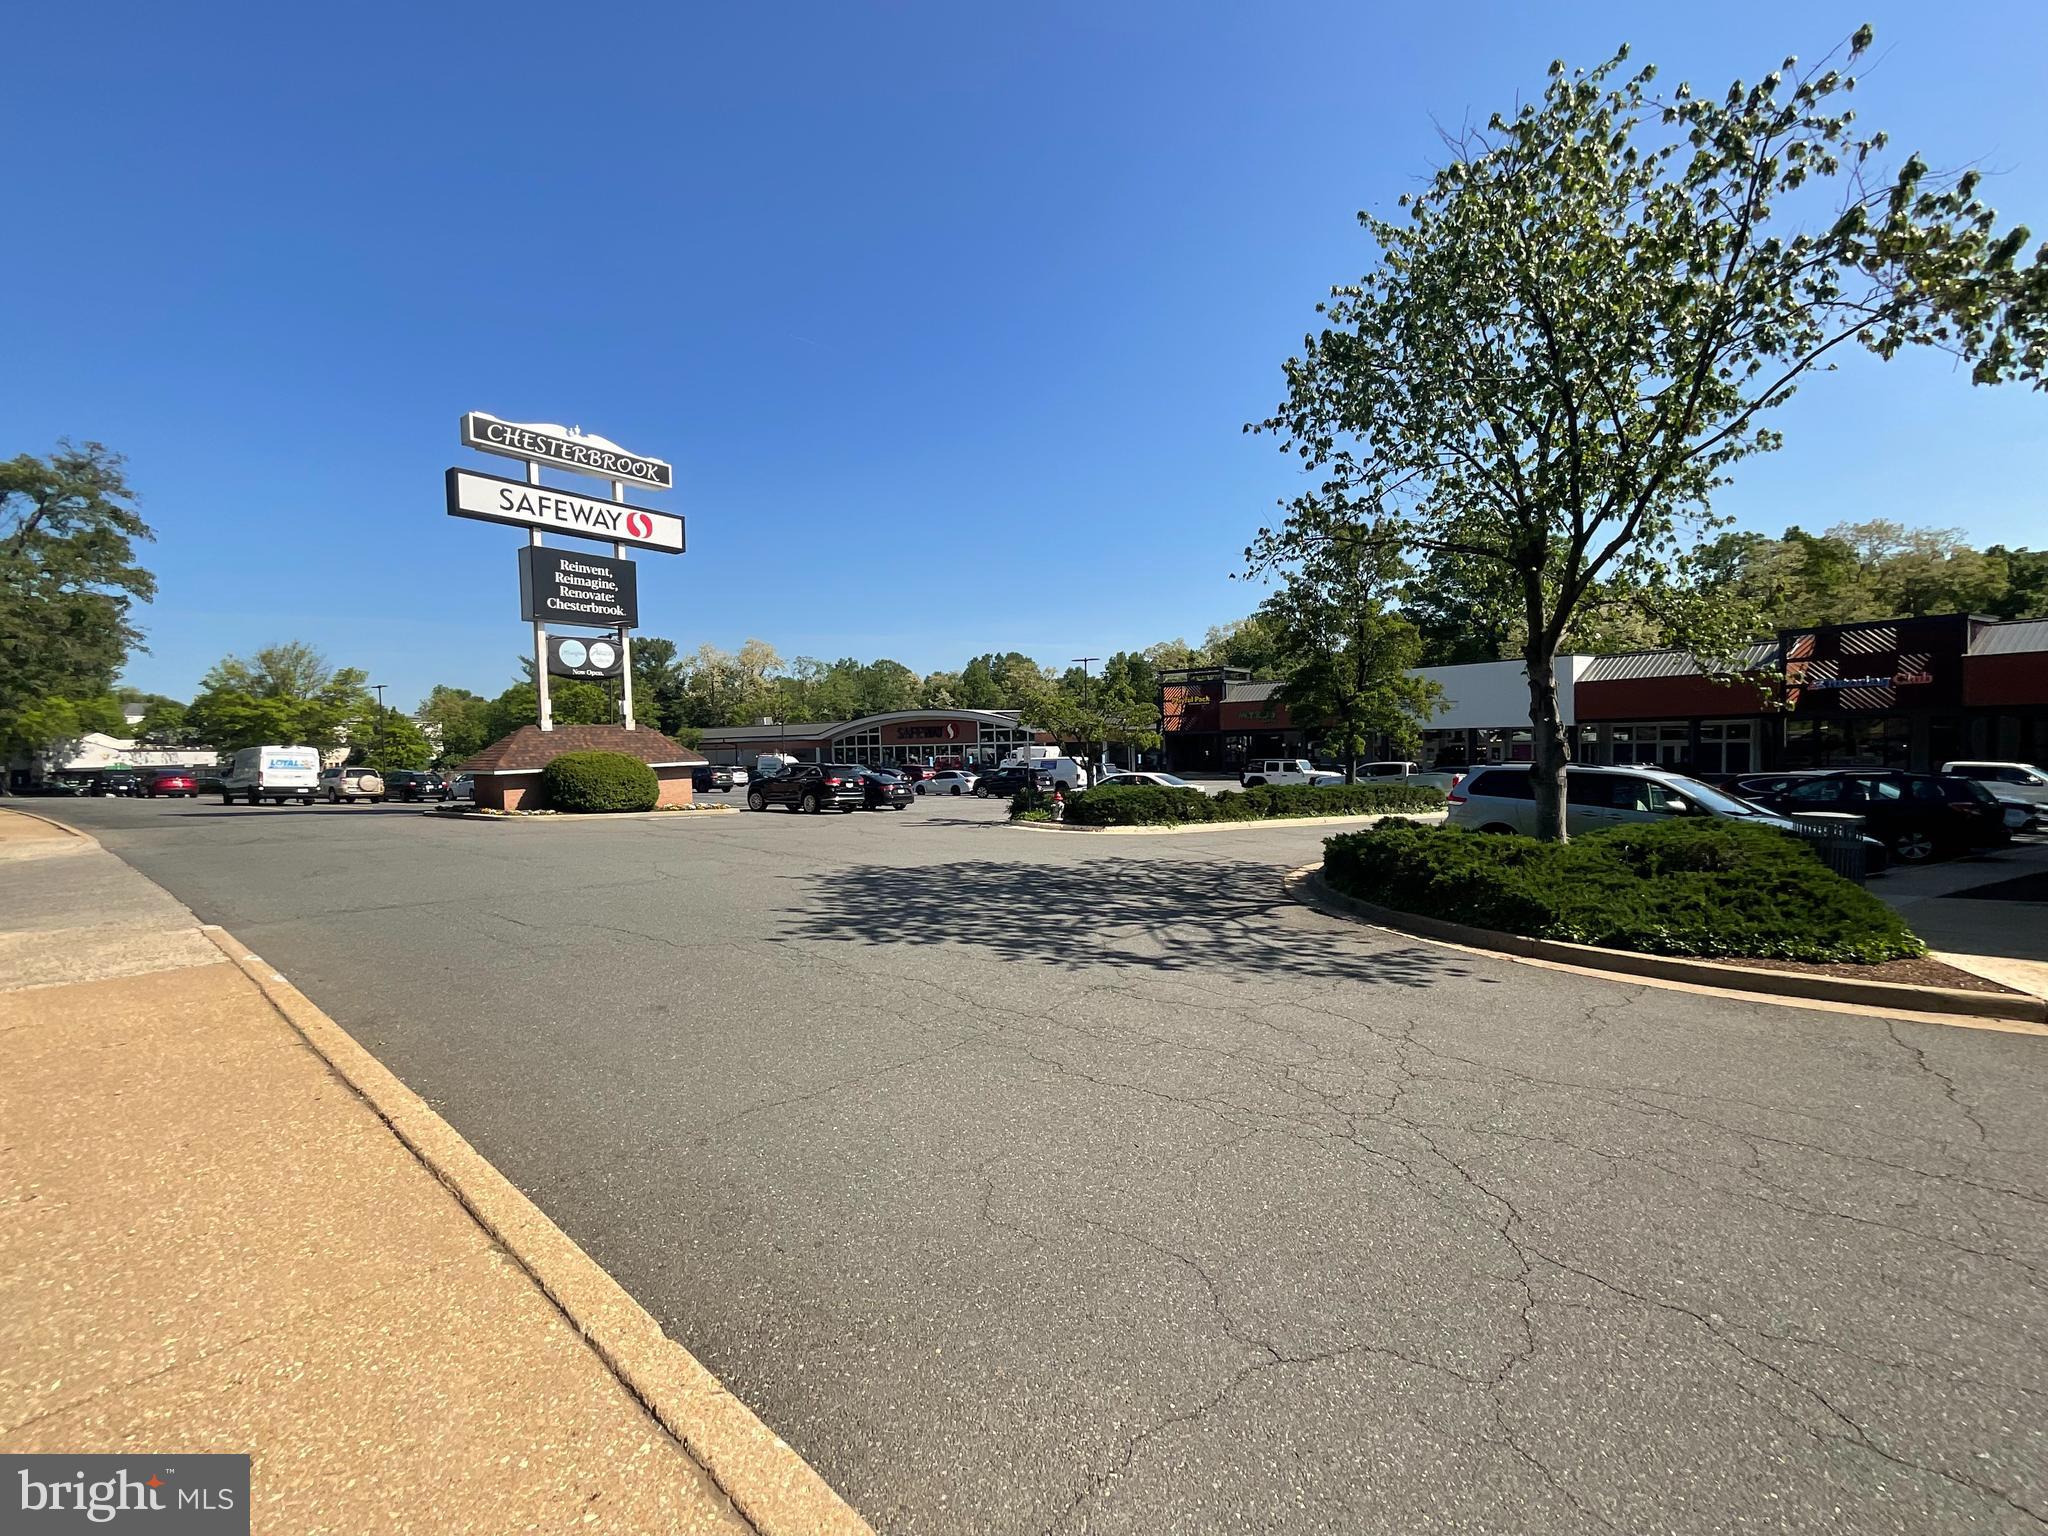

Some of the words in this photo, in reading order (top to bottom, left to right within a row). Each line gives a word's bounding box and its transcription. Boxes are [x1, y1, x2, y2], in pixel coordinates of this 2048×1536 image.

[487, 423, 661, 482] CHESTERBROOK
[499, 488, 622, 531] SAFEWAY
[560, 559, 613, 578] Reinvent,
[555, 571, 619, 592] Reimagine,
[559, 585, 615, 603] Renovate:
[546, 597, 627, 617] Chesterbrook.
